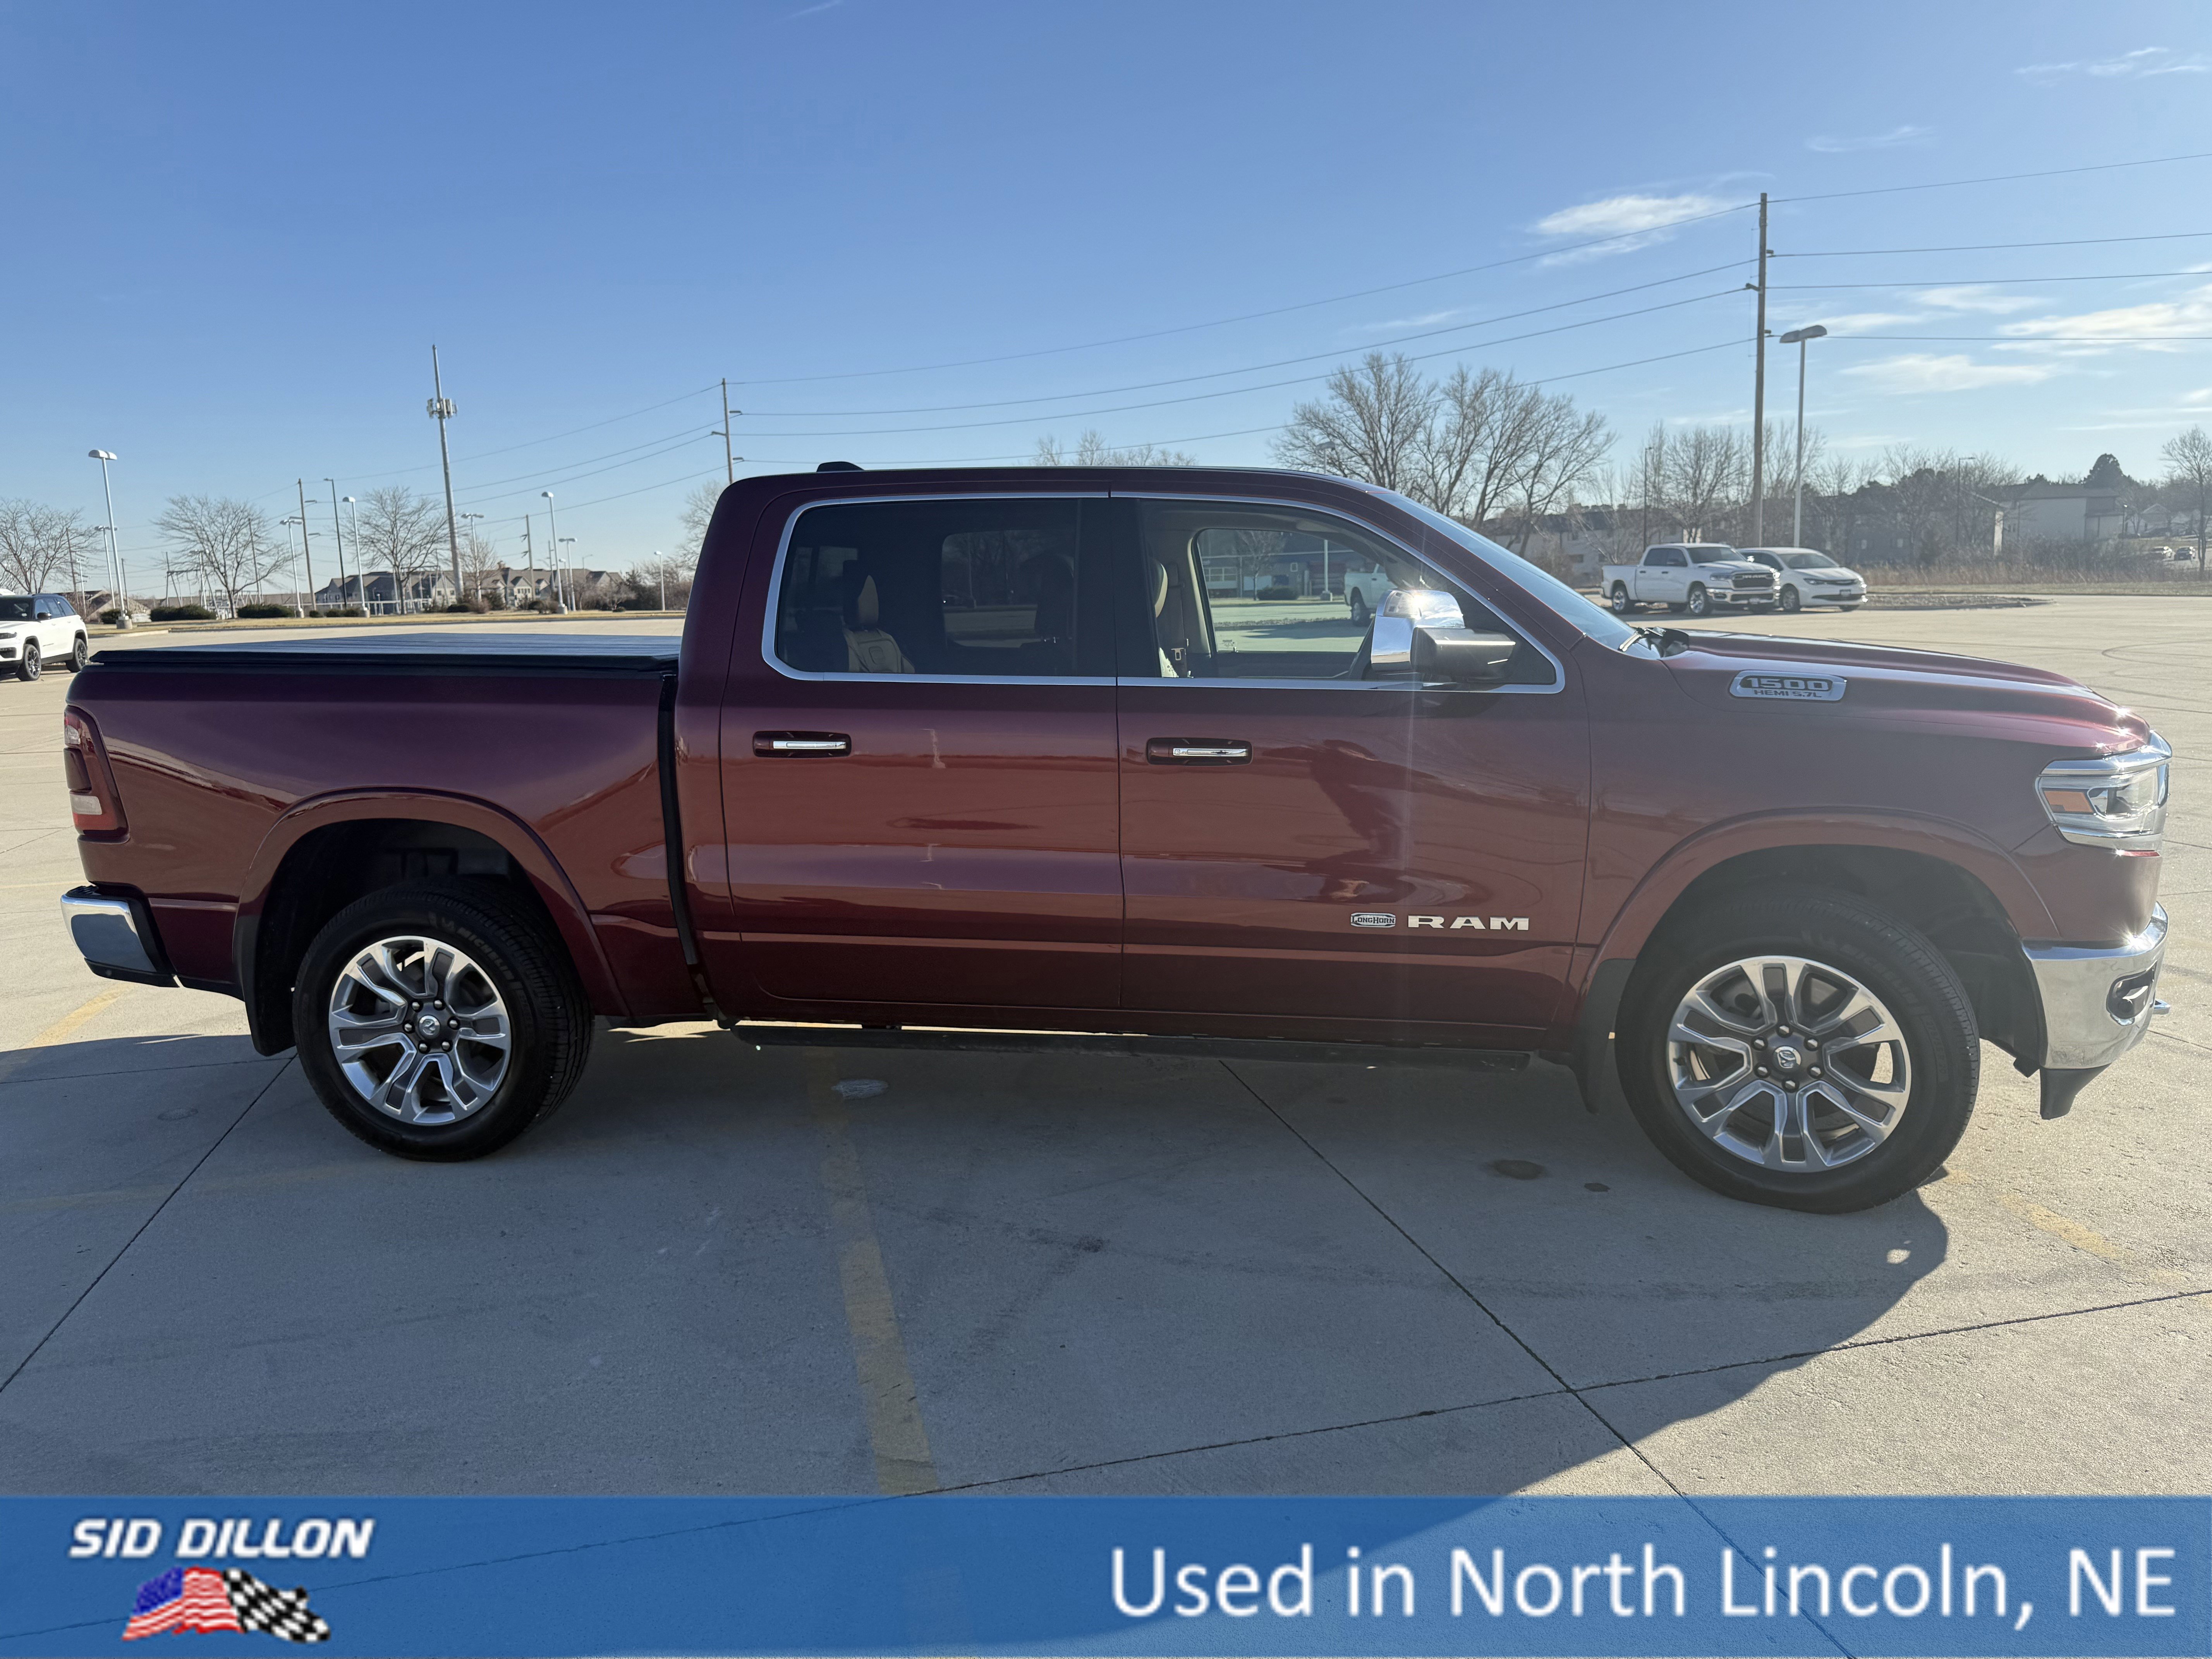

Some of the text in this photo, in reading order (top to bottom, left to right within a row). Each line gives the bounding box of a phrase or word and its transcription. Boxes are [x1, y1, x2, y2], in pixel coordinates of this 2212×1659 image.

[1746, 678, 1829, 691] 1500
[1408, 915, 1529, 930] RAM
[456, 927, 515, 981] MICHELIN
[1840, 944, 1919, 1004] MICHELIN
